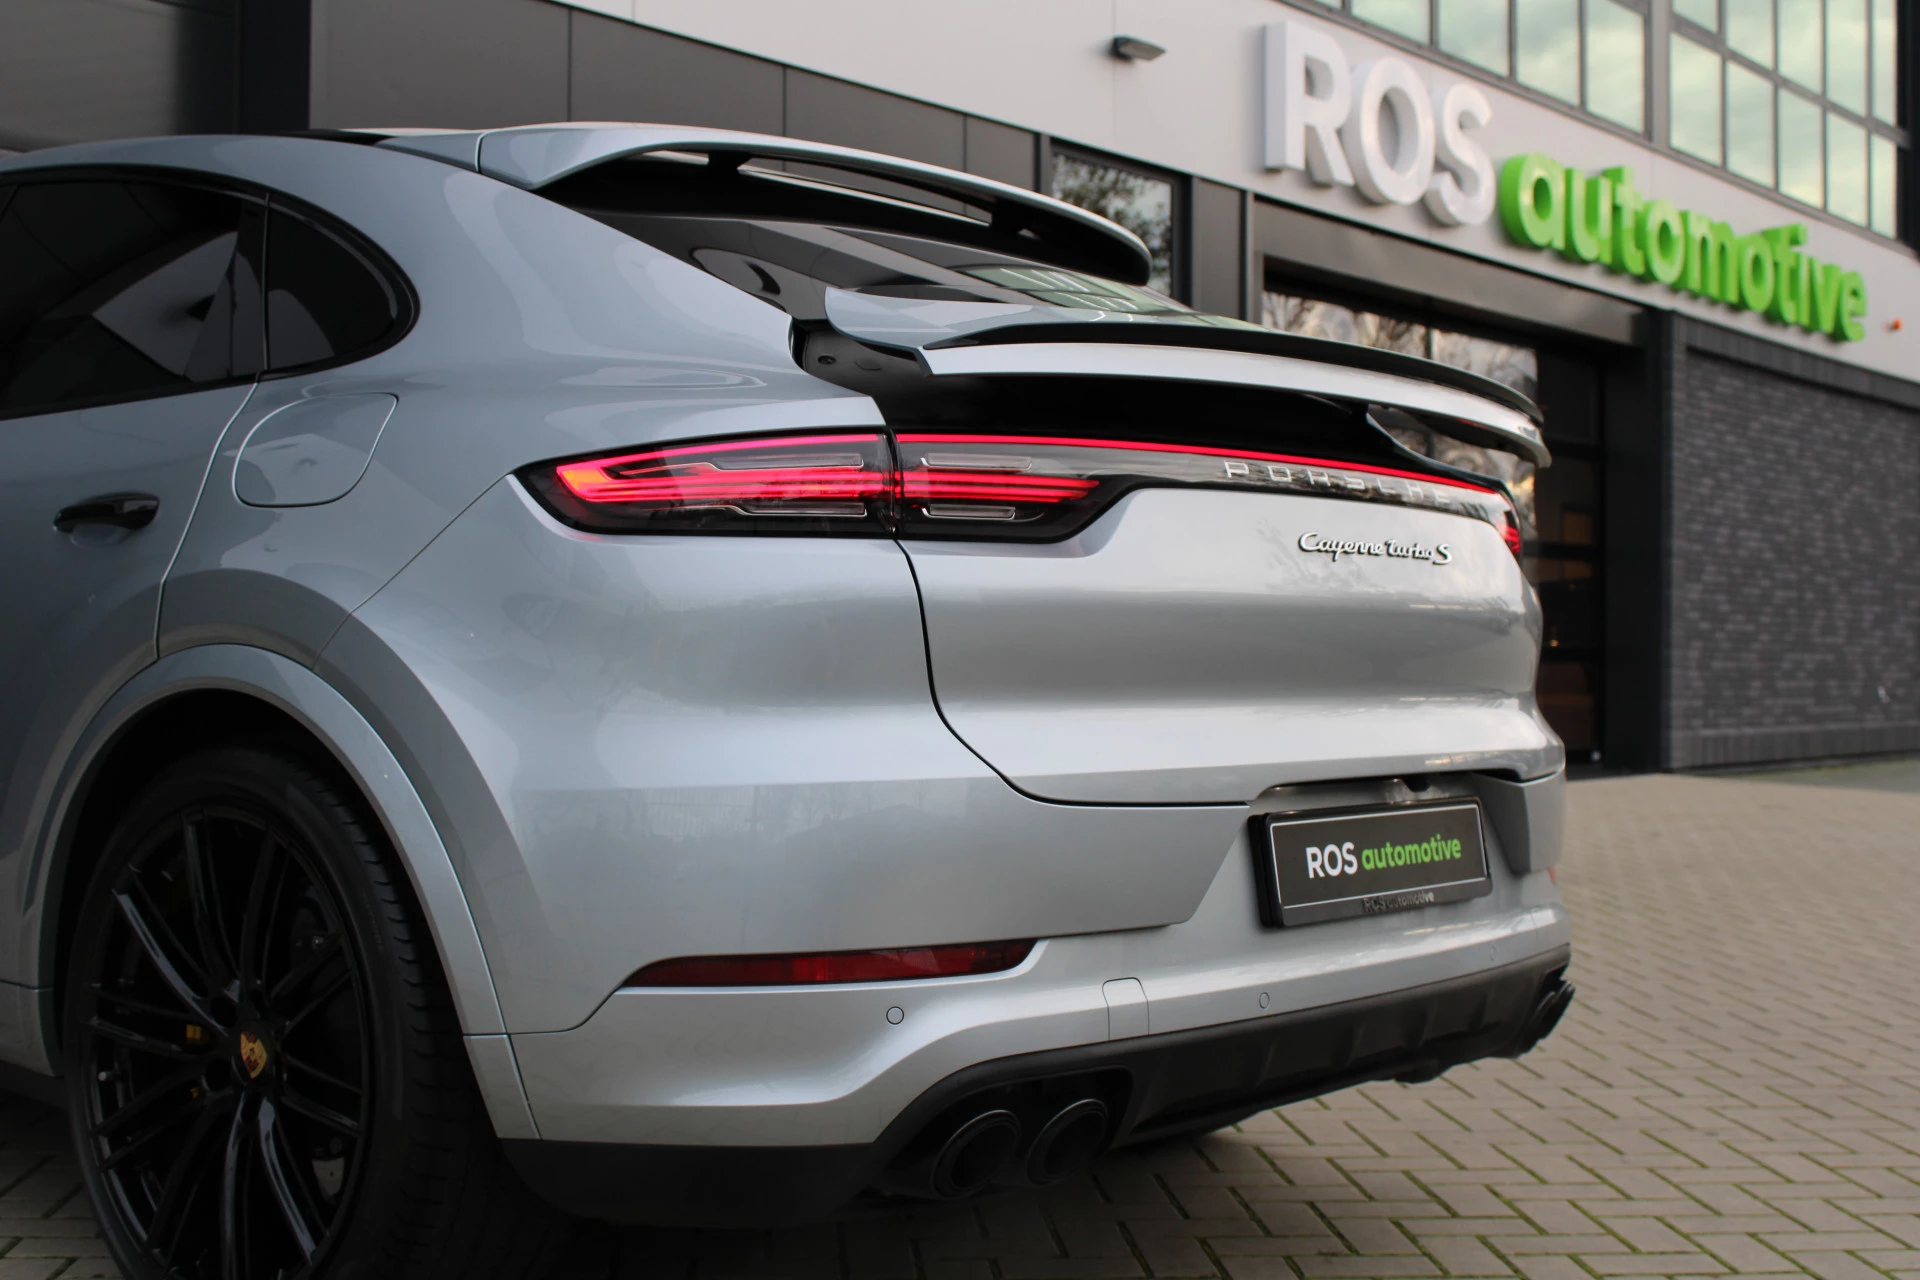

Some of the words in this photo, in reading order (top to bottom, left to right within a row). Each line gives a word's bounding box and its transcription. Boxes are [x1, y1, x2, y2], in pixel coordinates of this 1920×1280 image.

[1264, 20, 1496, 226] ROS
[1502, 151, 1867, 342] automotive
[1299, 531, 1384, 562] Cayenne
[1432, 543, 1453, 565] S
[1306, 841, 1358, 879] ROS
[1361, 833, 1462, 871] automotive
